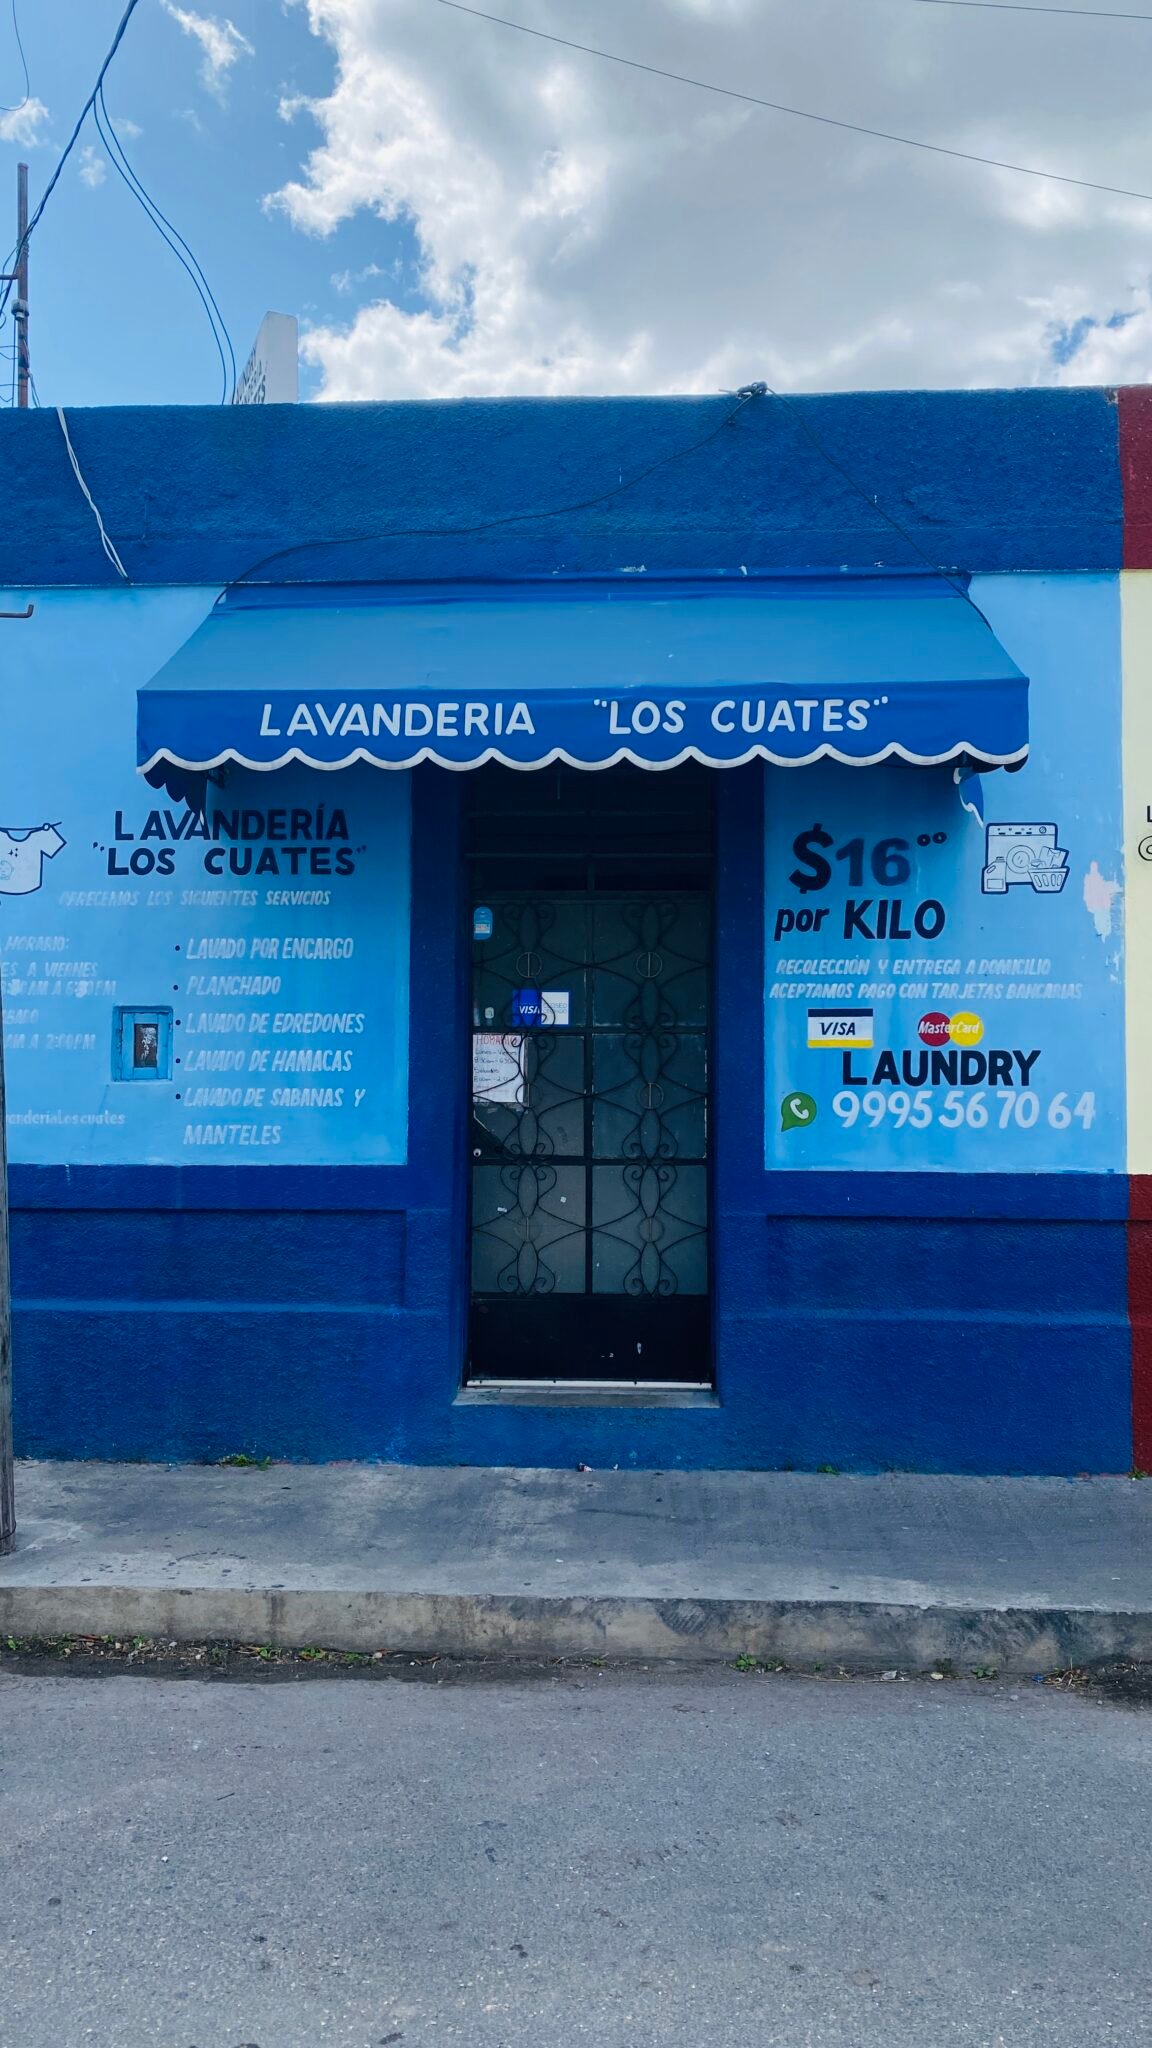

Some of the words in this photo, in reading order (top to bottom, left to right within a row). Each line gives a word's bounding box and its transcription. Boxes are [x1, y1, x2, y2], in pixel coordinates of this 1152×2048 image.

[260, 702, 536, 737] LAVANDERIA
[115, 803, 350, 841] LAVANDERÍA
[265, 889, 332, 907] SERVICIOS
[774, 907, 830, 942] por
[844, 898, 946, 940] KILO
[186, 937, 246, 960] LAVADO
[249, 937, 280, 960] POR
[282, 937, 354, 960] ENCARGO
[44, 961, 99, 978] VIERNES
[878, 959, 889, 975] Y
[893, 958, 961, 975] ENTREGA
[965, 959, 976, 975] A
[977, 958, 1052, 975] DOMICILIO
[186, 975, 282, 997] PLANCHADO
[769, 982, 856, 1000] ACEPTAMOS
[857, 982, 897, 1000] PAGO
[899, 982, 928, 1000] CON
[931, 982, 1004, 1000] TARJETAS
[1006, 982, 1085, 1000] BANCARIAS
[185, 1012, 247, 1034] LAVADO
[249, 1012, 271, 1034] DE
[272, 1012, 366, 1034] EDREDONES
[820, 1021, 857, 1037] VISA
[918, 1020, 981, 1036] MasterCard
[184, 1050, 246, 1072] LAVADO
[248, 1050, 271, 1072] DE
[271, 1049, 353, 1072] HAMACAS
[842, 1050, 1042, 1087] LAUNDRY
[184, 1087, 242, 1108] LAVADO
[244, 1087, 267, 1108] DE
[269, 1087, 346, 1108] SABANAS
[354, 1088, 368, 1108] Y
[183, 1124, 283, 1146] MANTELES
